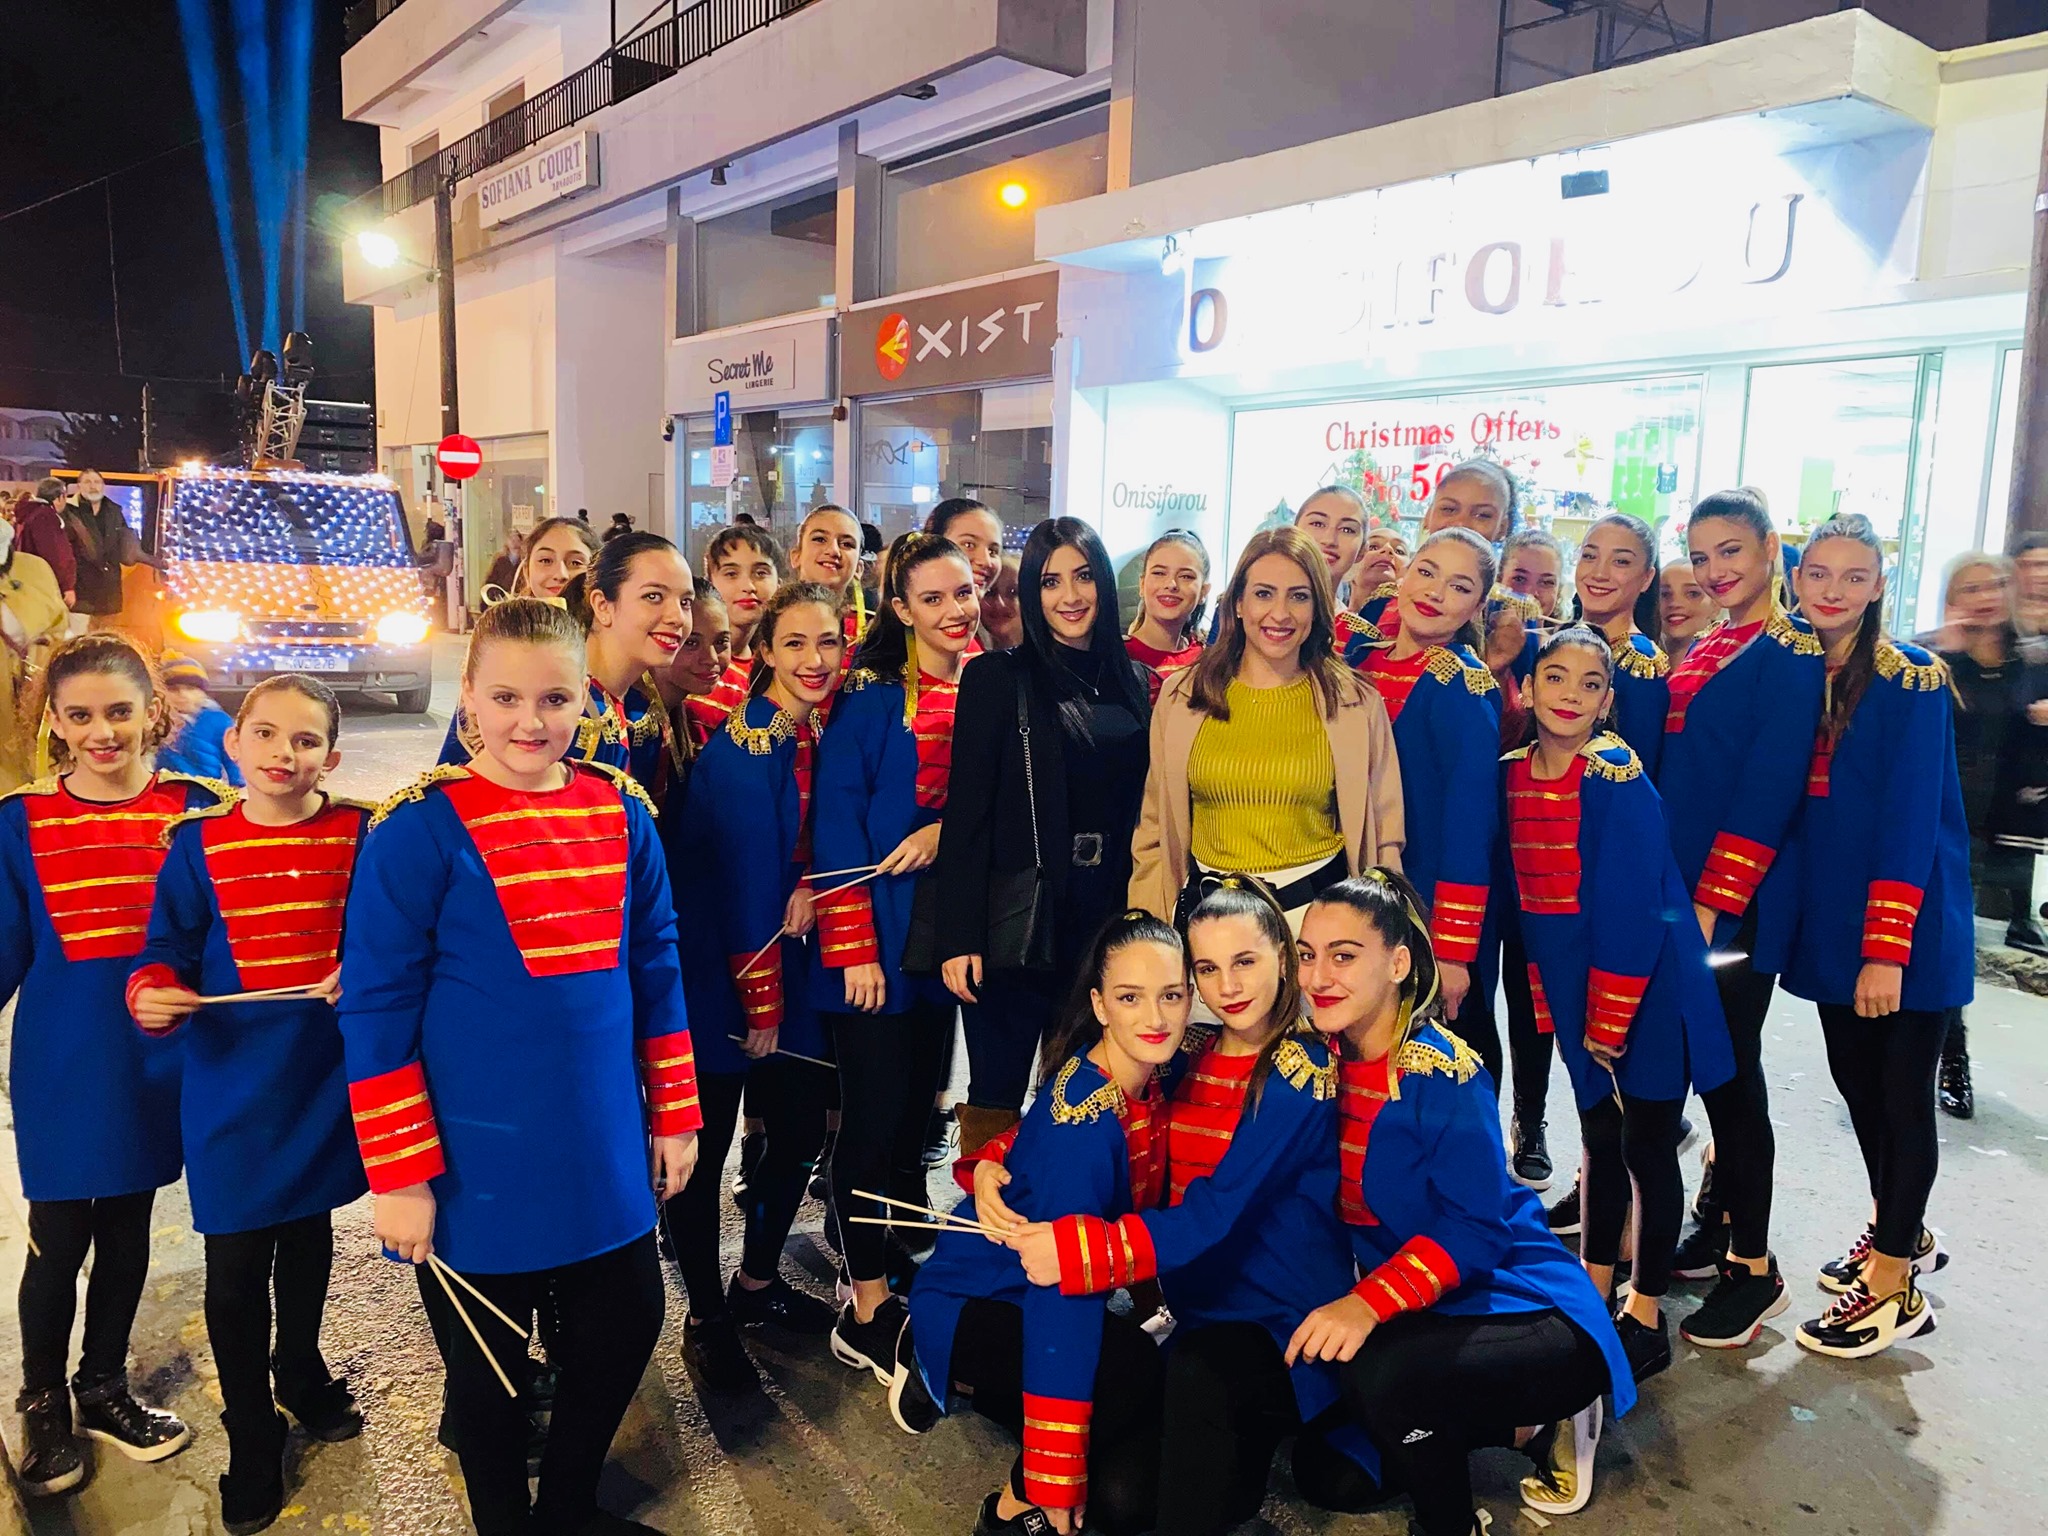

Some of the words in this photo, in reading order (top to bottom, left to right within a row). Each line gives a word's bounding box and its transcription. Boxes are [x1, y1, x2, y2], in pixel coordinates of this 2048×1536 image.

[481, 165, 533, 209] SOFIANA
[538, 140, 582, 184] COURT
[879, 301, 1044, 363] EXIST
[707, 356, 751, 384] Secret
[752, 350, 774, 377] Me
[745, 378, 774, 389] LINGERIE
[717, 395, 727, 430] P
[1325, 420, 1456, 452] Christmas
[1471, 409, 1561, 445] Offers
[1376, 464, 1403, 483] UP
[1112, 482, 1208, 517] Onisiforou
